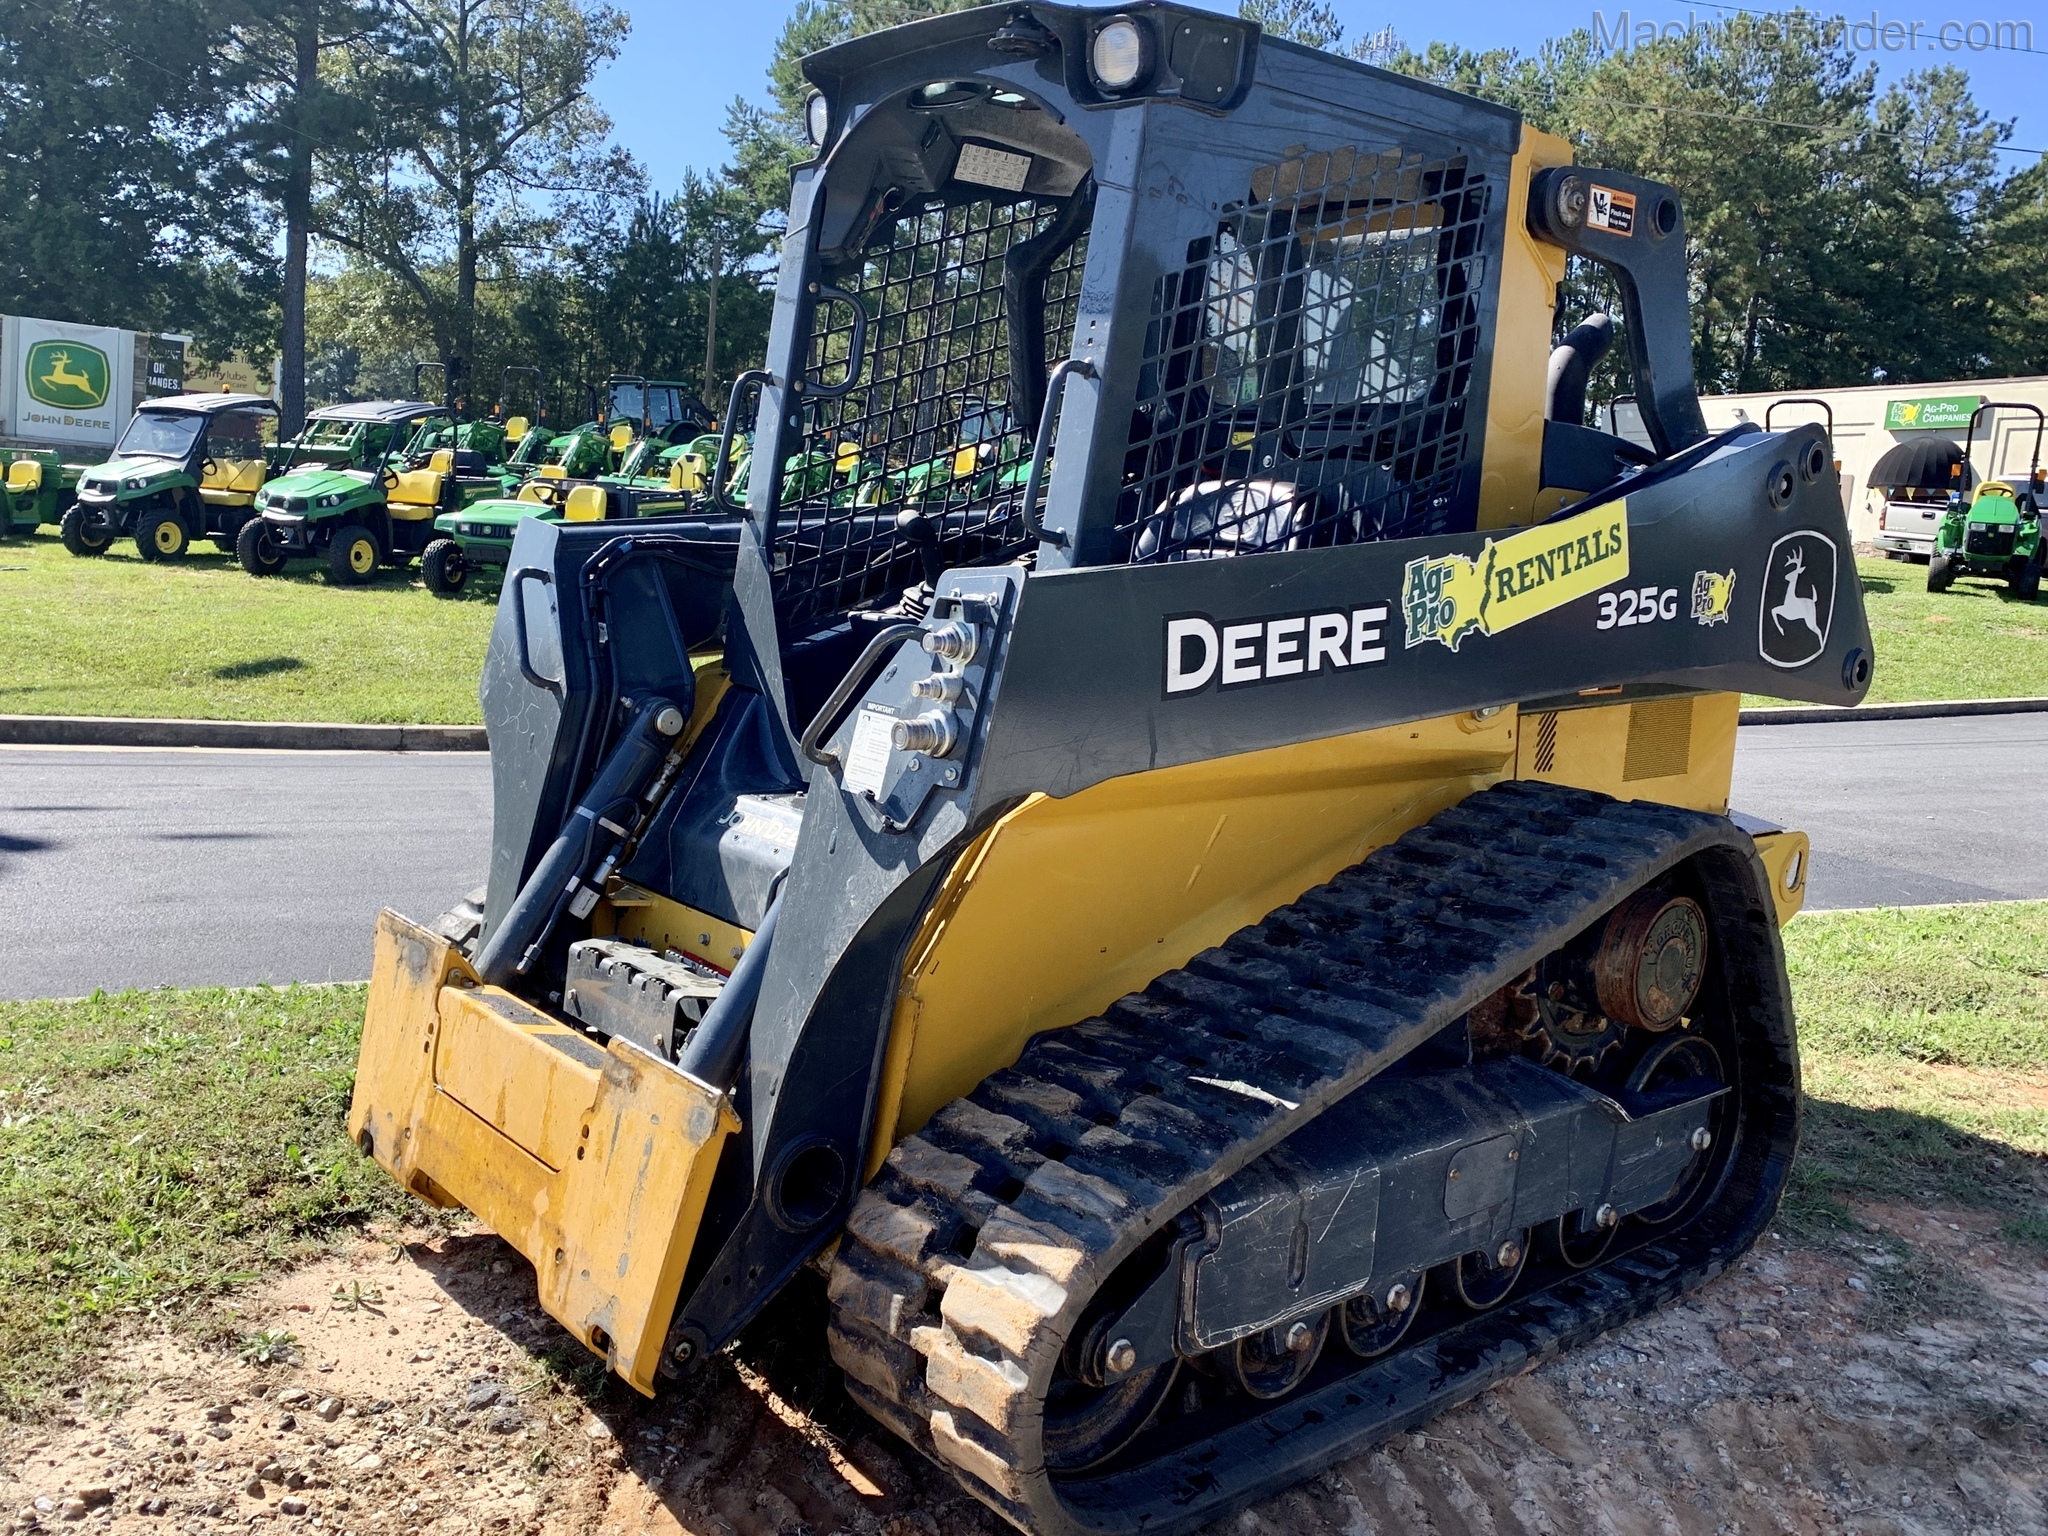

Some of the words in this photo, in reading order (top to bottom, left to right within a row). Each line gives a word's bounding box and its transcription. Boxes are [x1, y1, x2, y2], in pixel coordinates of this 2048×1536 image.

[147, 376, 181, 390] ANGES.
[227, 370, 247, 381] lube
[1924, 403, 1959, 413] AG-PRO
[22, 412, 61, 425] JOHN
[63, 415, 111, 429] DEERE
[1922, 413, 1972, 423] COMPANIES
[1495, 522, 1622, 604] RENTALS
[1407, 561, 1454, 605] Ag-
[1596, 586, 1678, 630] 325G
[1694, 595, 1714, 614] Pro
[1408, 598, 1456, 641] Pro
[1167, 607, 1388, 693] DEERE
[867, 702, 895, 715] IMPORTANT
[715, 809, 769, 838] JOHN
[761, 819, 800, 847] DEE
